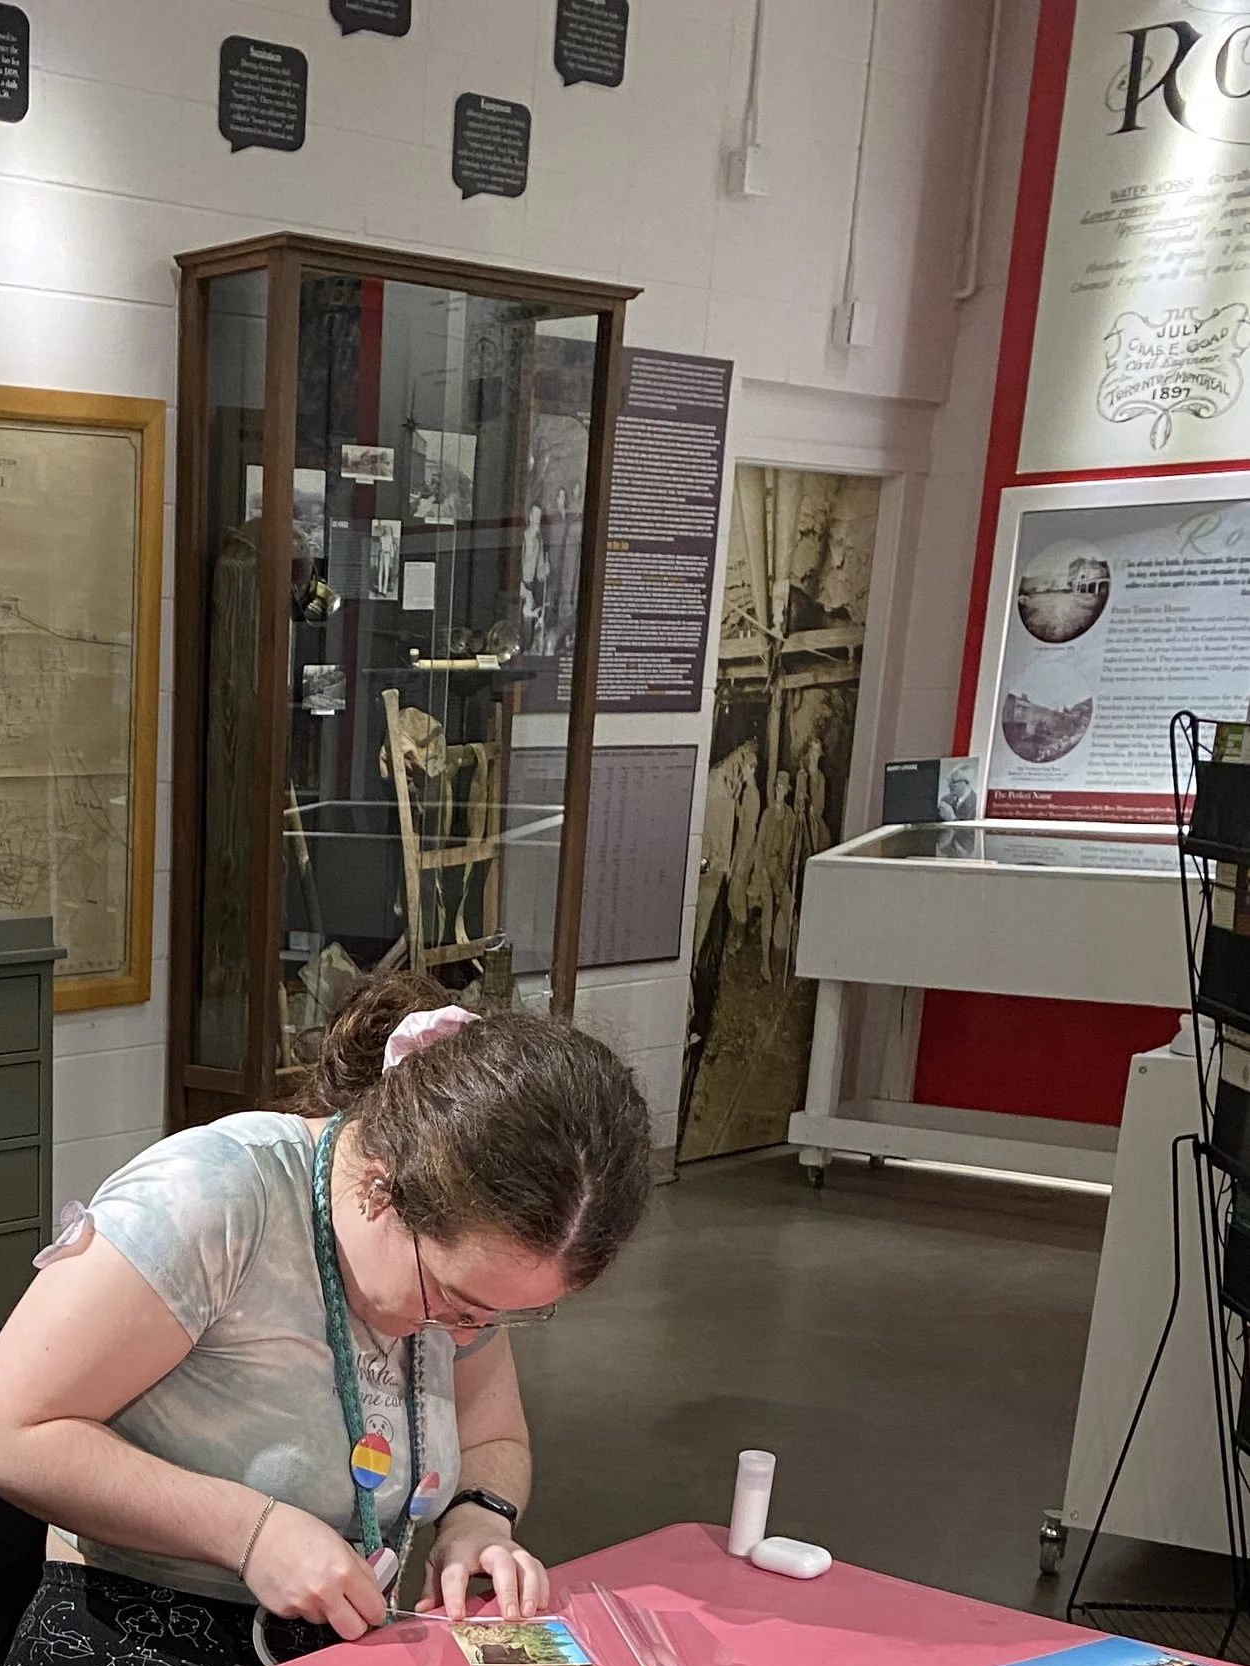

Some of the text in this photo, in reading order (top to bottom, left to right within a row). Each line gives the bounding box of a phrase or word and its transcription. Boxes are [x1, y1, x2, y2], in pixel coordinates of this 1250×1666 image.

[1110, 178, 1194, 200] WATER WORKS
[1157, 323, 1203, 338] JULY
[1186, 327, 1229, 353] GOAD
[1152, 386, 1192, 401] 1897
